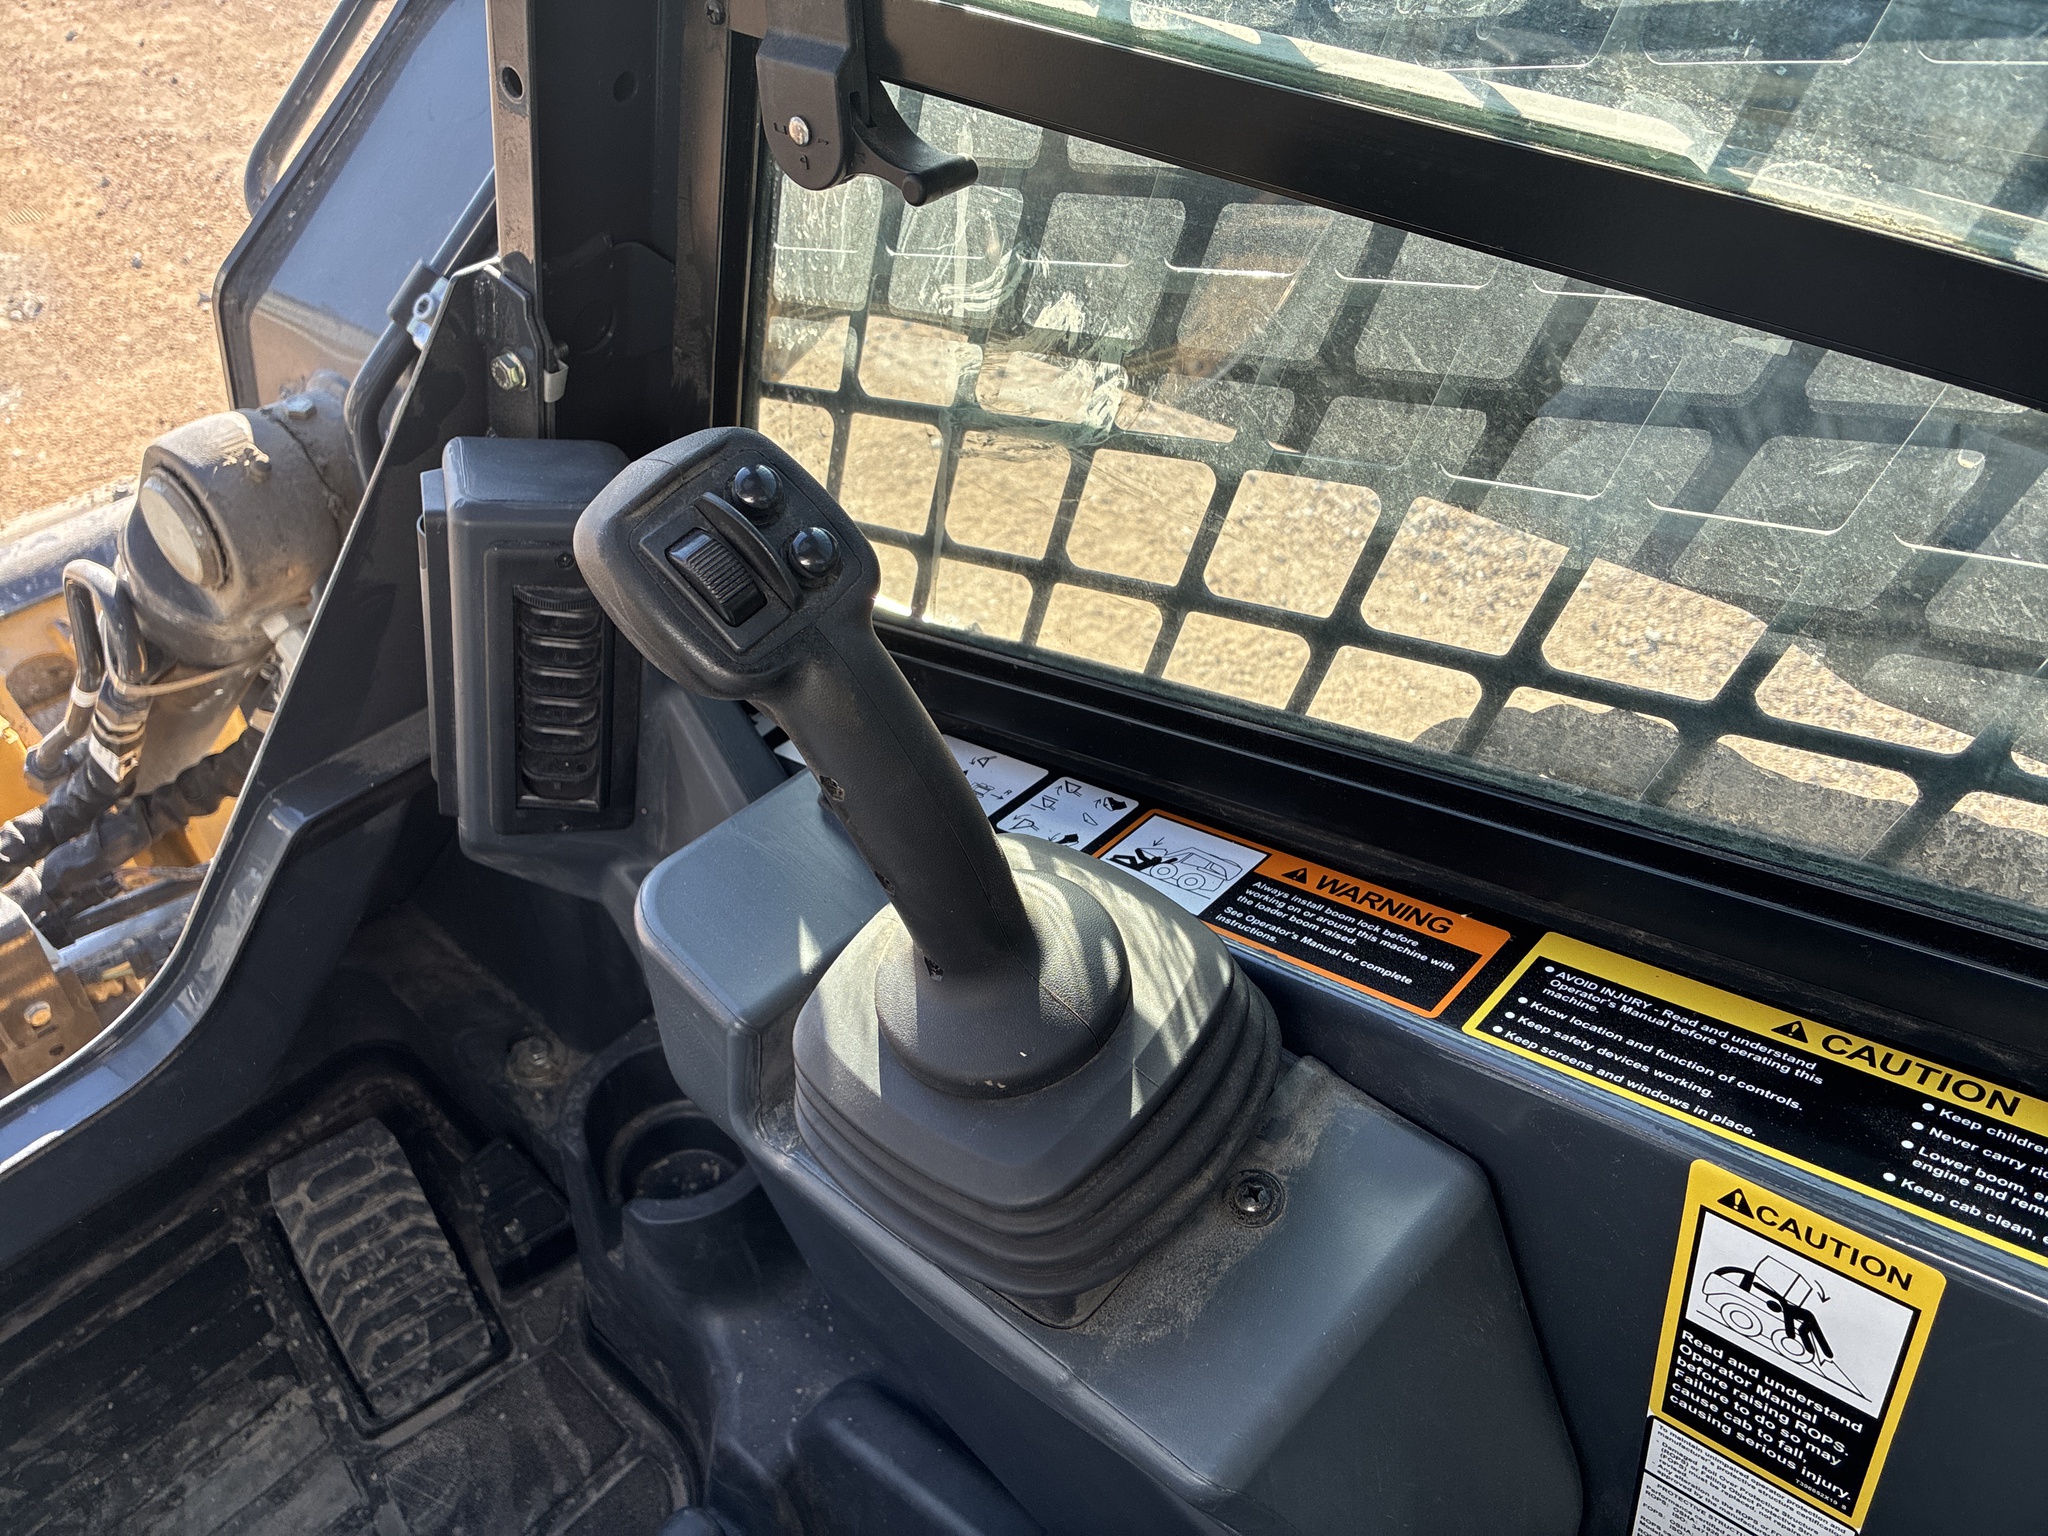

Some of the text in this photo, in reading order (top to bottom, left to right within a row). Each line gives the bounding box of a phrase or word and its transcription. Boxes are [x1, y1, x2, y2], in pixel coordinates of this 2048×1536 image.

[1215, 914, 1277, 943] instructions.
[1237, 896, 1357, 945] the loader boom raised.
[1246, 889, 1286, 908] working
[1287, 905, 1301, 913] on
[1316, 916, 1356, 933] around
[1357, 930, 1377, 942] this
[1379, 940, 1428, 961] machine
[1431, 959, 1455, 971] with
[1253, 882, 1418, 946] Always install boom lock before
[1316, 874, 1454, 934] WARNING
[1224, 907, 1412, 984] See Operator's Manual for complete
[1543, 988, 1598, 1013] machine.
[1550, 980, 1822, 1084] Operator's Manual before operating this
[1556, 972, 1598, 990] AVOID
[1600, 987, 1652, 1009] INJURY
[1662, 1009, 1699, 1027] Read
[1701, 1025, 1729, 1038] and
[1732, 1036, 1816, 1070] understand
[1504, 1031, 1755, 1136] Keep screens and windows in place.
[1517, 1016, 1713, 1098] Keep safety devices working.
[1530, 1001, 1802, 1110] Know location and function of controls.
[1821, 1034, 2021, 1117] CAUTION
[1929, 1127, 1979, 1151] Never
[1983, 1149, 2026, 1170] carry
[1940, 1109, 1982, 1130] Keep
[1901, 1178, 2036, 1240] Keep cab clean,
[1912, 1160, 1970, 1186] engine
[1974, 1184, 2007, 1200] and
[1919, 1146, 1972, 1172] Lower
[1975, 1168, 2027, 1196] boom,
[1756, 1205, 1913, 1291] CAUTION
[1675, 1368, 1841, 1465] Failure to do so may
[1677, 1356, 1848, 1456] before raising ROPS.
[1680, 1344, 1817, 1423] Operator Manual
[1682, 1330, 1863, 1433] Read and understand
[1670, 1395, 1850, 1500] causing serious injury.
[1672, 1383, 1806, 1463] cause cab to fall,
